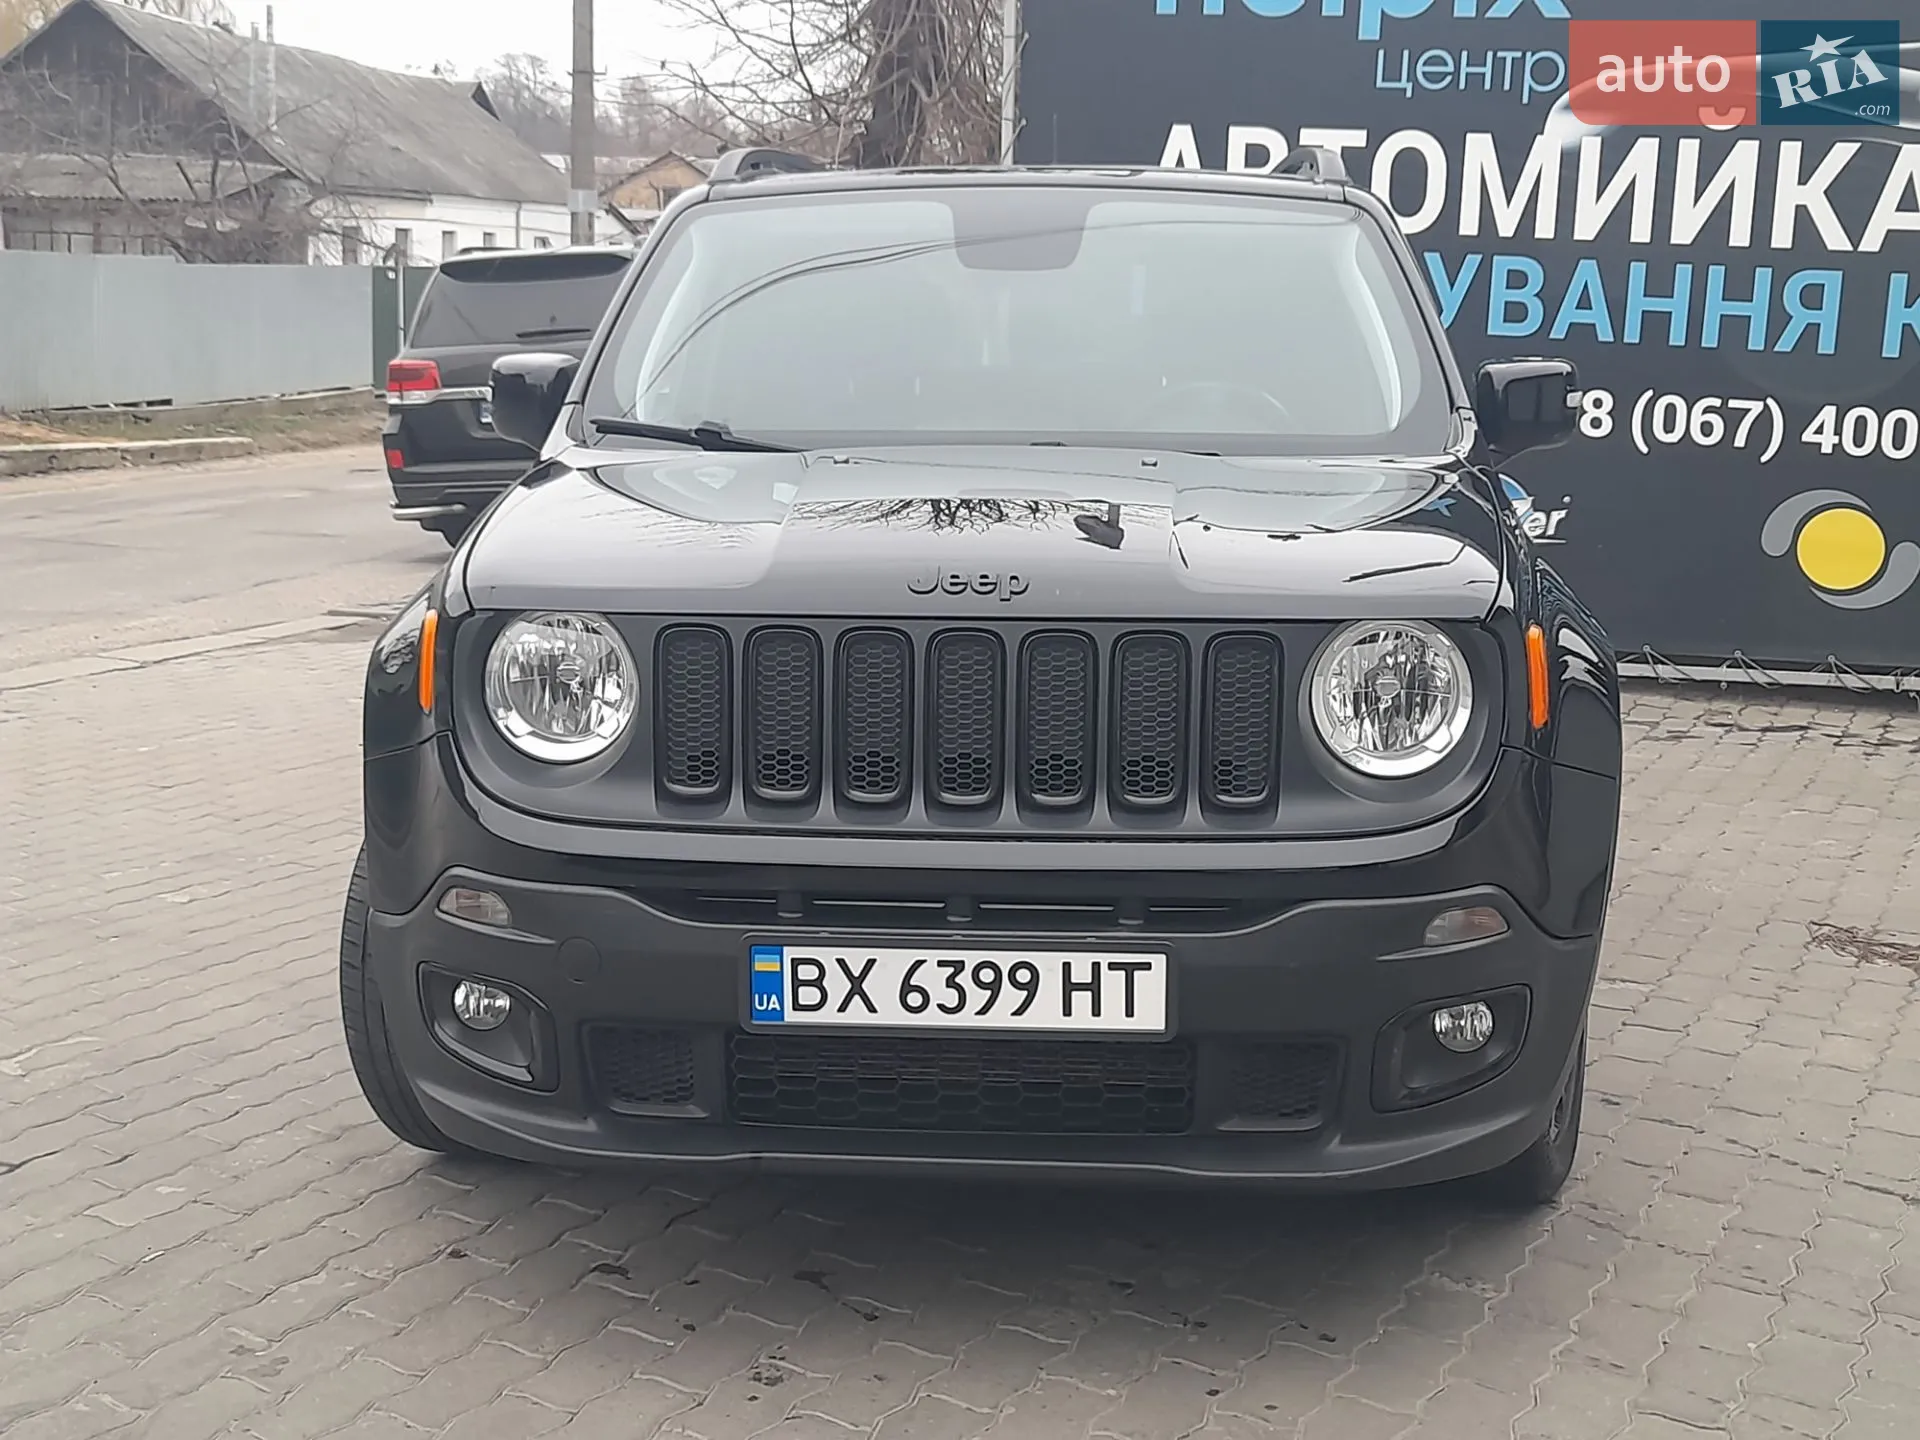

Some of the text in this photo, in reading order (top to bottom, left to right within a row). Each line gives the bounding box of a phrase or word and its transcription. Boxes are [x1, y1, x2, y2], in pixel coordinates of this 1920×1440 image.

[1375, 48, 1566, 104] центр
[1631, 388, 1785, 463] (067)
[906, 565, 1030, 602] Jeep
[755, 993, 781, 1011] UA
[790, 957, 1153, 1018] BX 6399 HT
